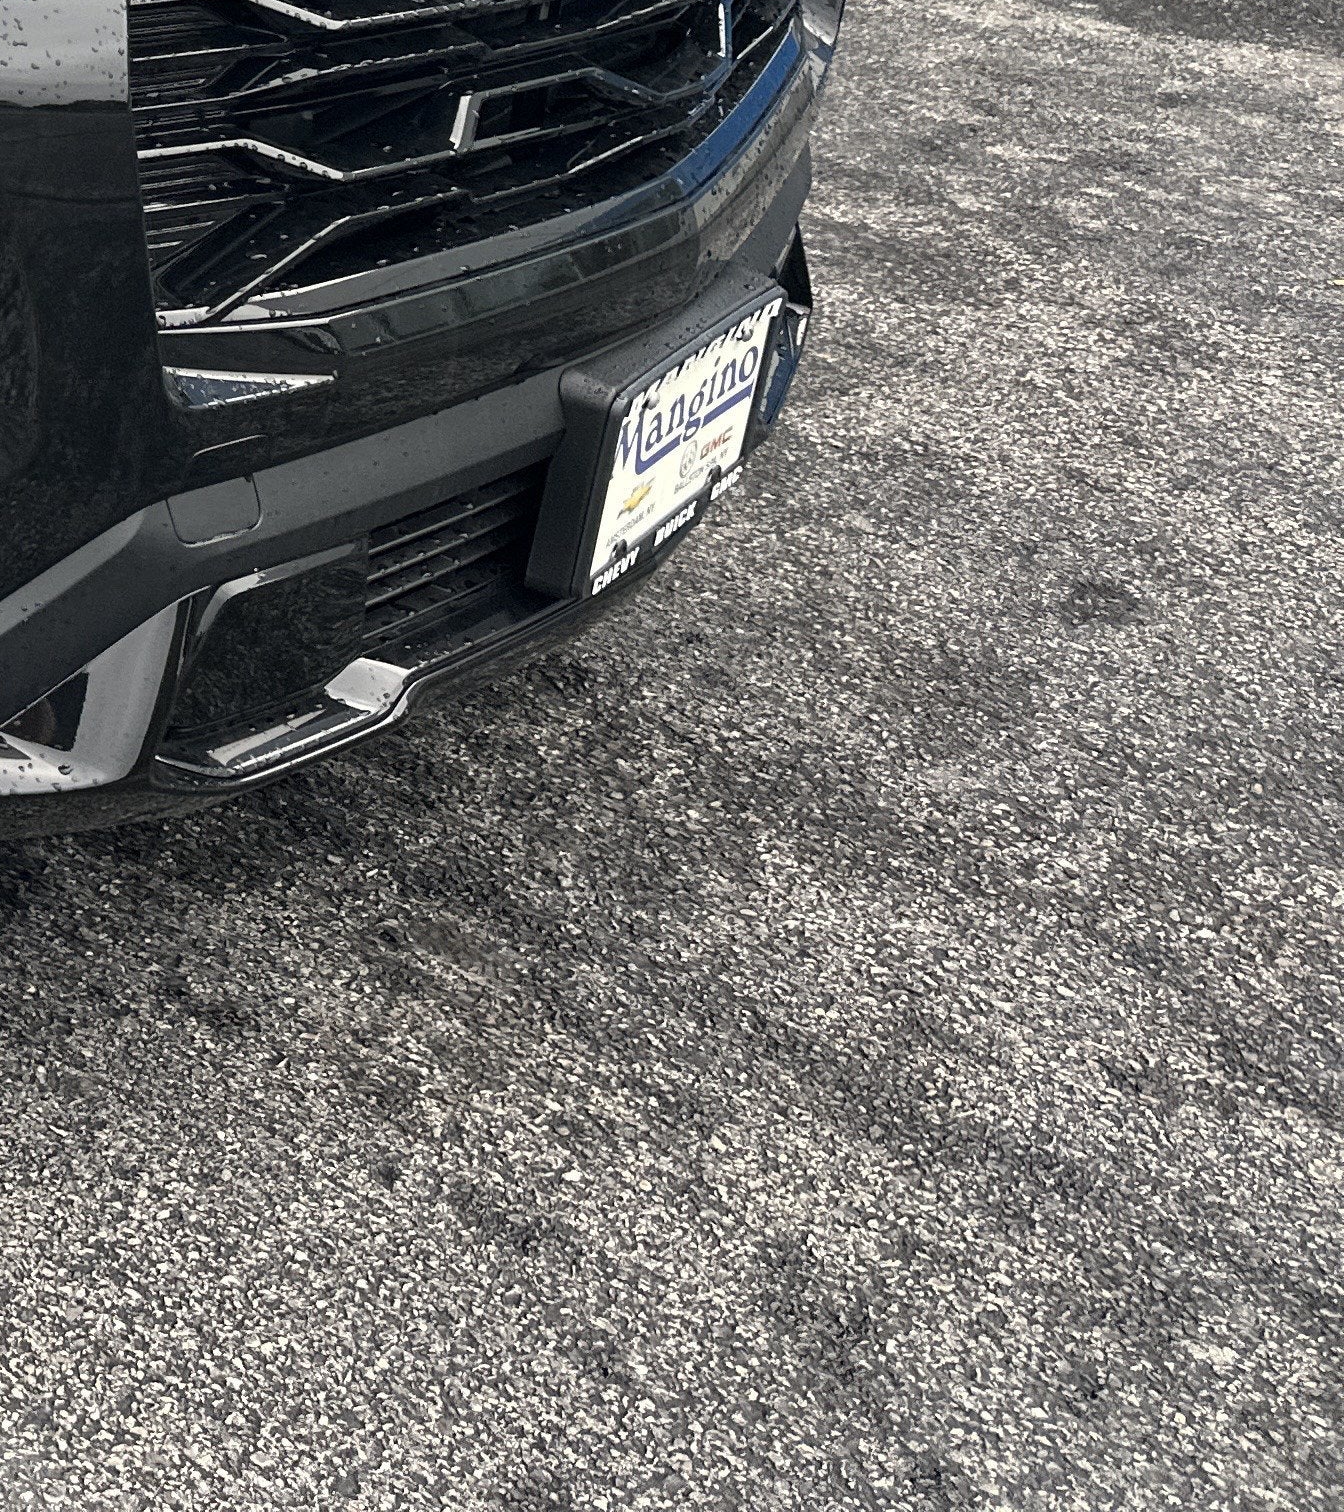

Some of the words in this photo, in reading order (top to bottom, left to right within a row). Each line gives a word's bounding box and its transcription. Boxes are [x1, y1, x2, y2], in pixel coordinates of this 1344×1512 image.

[614, 345, 759, 474] Mangino
[699, 425, 733, 460] GMC
[592, 547, 640, 595] CHEVY
[654, 501, 697, 547] BUICK
[710, 466, 743, 500] GMC
